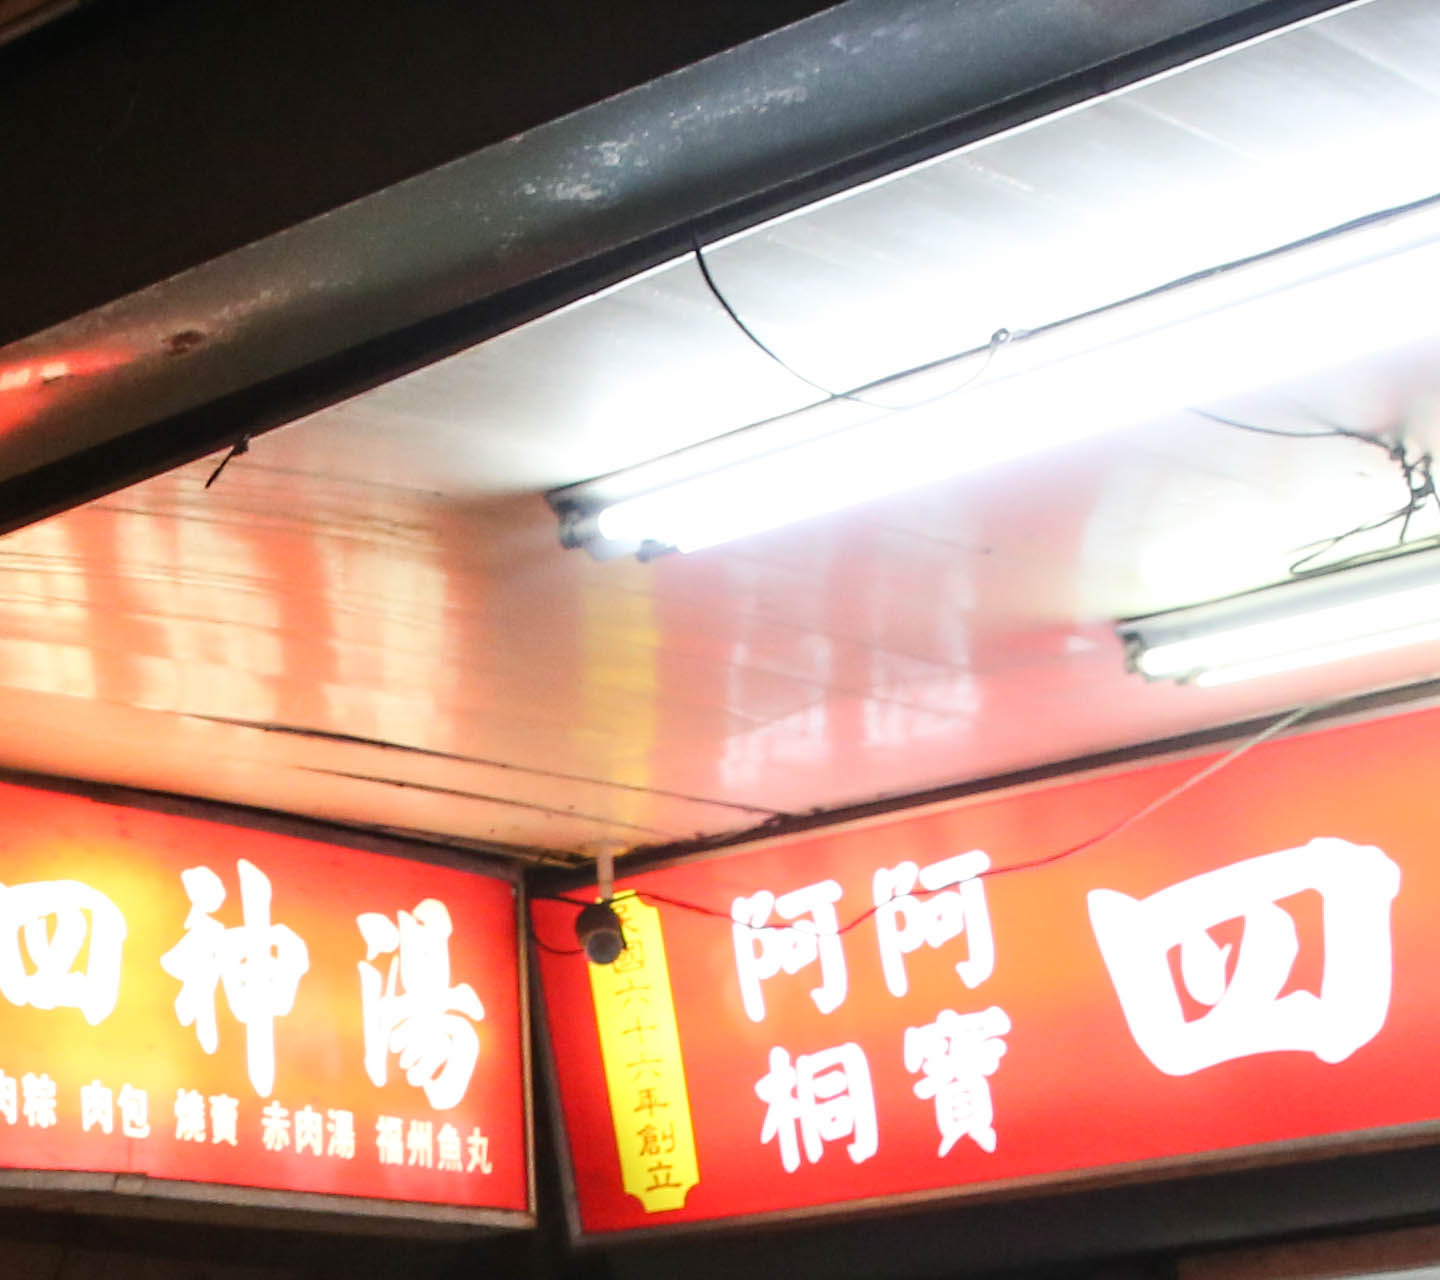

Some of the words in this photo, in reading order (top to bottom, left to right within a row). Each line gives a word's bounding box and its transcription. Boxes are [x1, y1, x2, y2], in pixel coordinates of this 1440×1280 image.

[80, 1080, 150, 1140] 肉包
[174, 1088, 240, 1148] 燒賣
[261, 1104, 356, 1162] 赤肉湯
[375, 1114, 494, 1176] 福州魚丸
